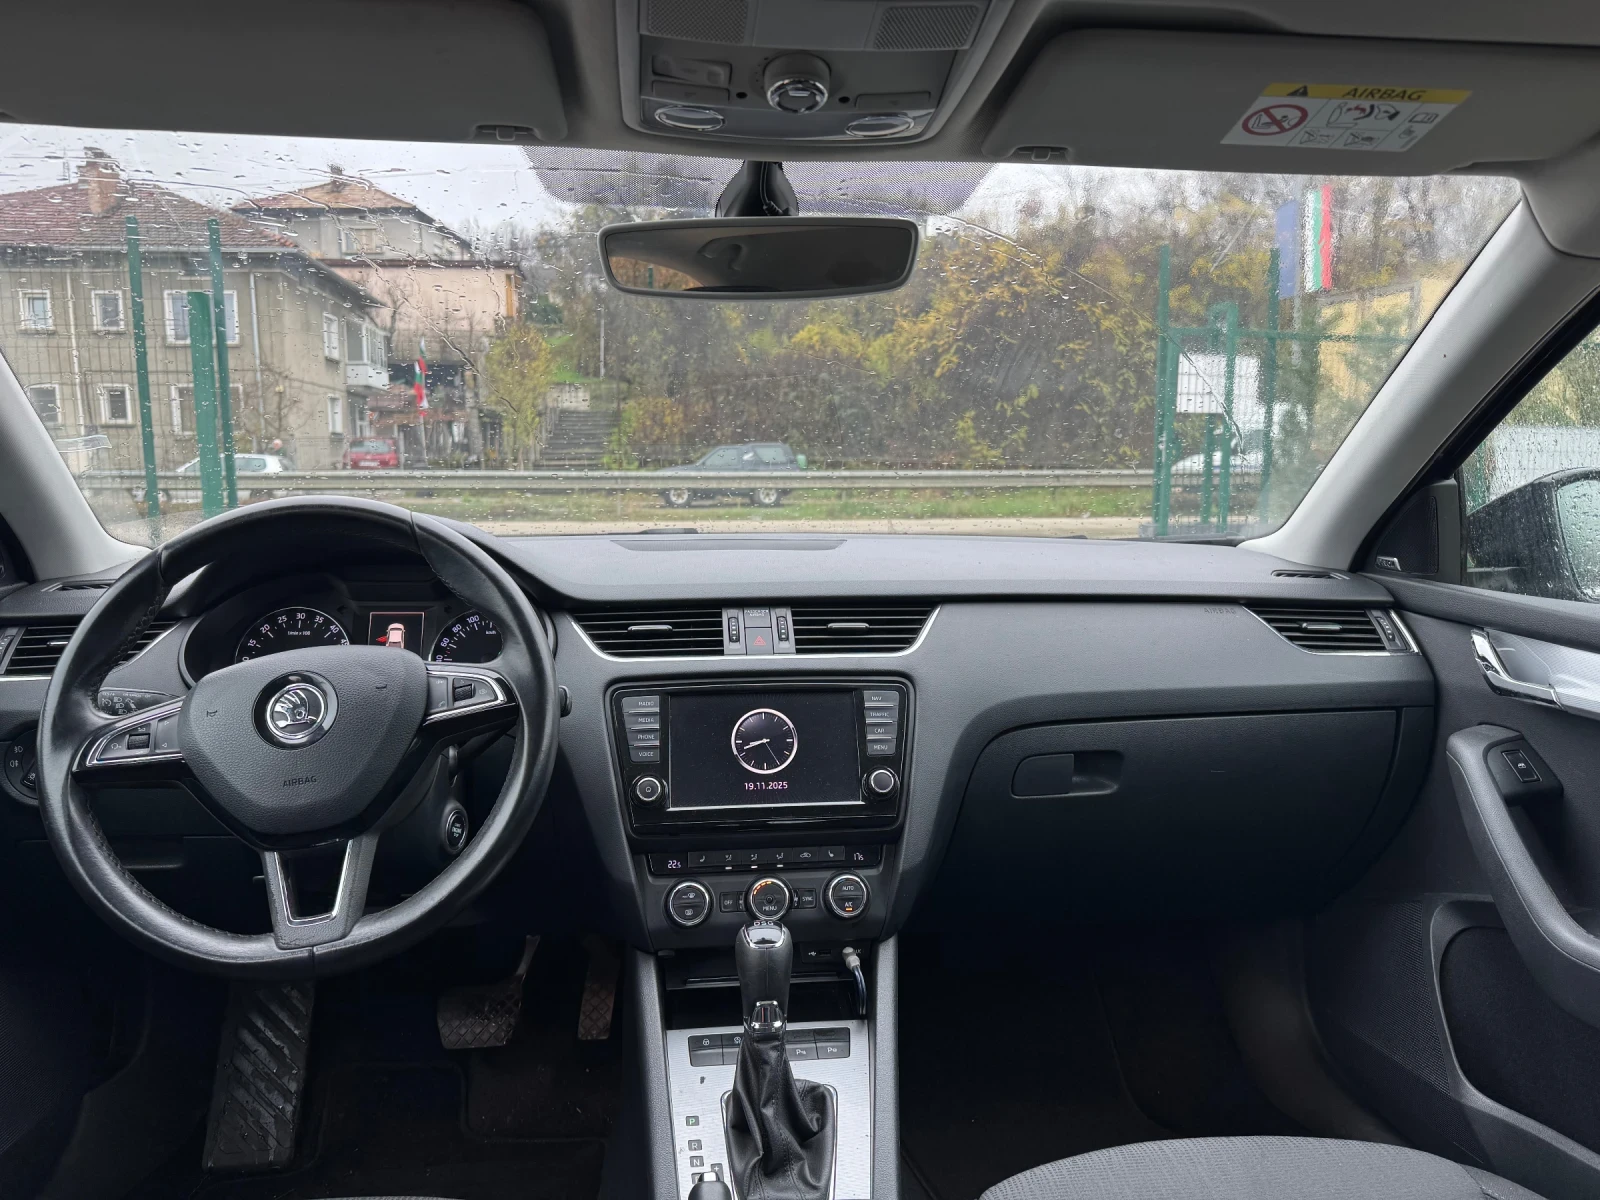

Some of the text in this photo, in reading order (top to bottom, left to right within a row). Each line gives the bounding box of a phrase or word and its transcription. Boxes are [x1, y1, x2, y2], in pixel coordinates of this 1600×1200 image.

[1342, 87, 1427, 101] AIRBAG
[277, 614, 288, 624] 25
[296, 612, 306, 620] 30
[314, 615, 325, 624] 35
[466, 614, 480, 625] 100
[259, 623, 271, 634] 20
[329, 623, 340, 634] 40
[451, 623, 463, 634] 80
[247, 638, 257, 648] 15
[440, 637, 450, 648] 60
[283, 776, 317, 788] AIRBAG
[744, 781, 788, 790] 19.11.2025
[693, 1158, 700, 1166] N
